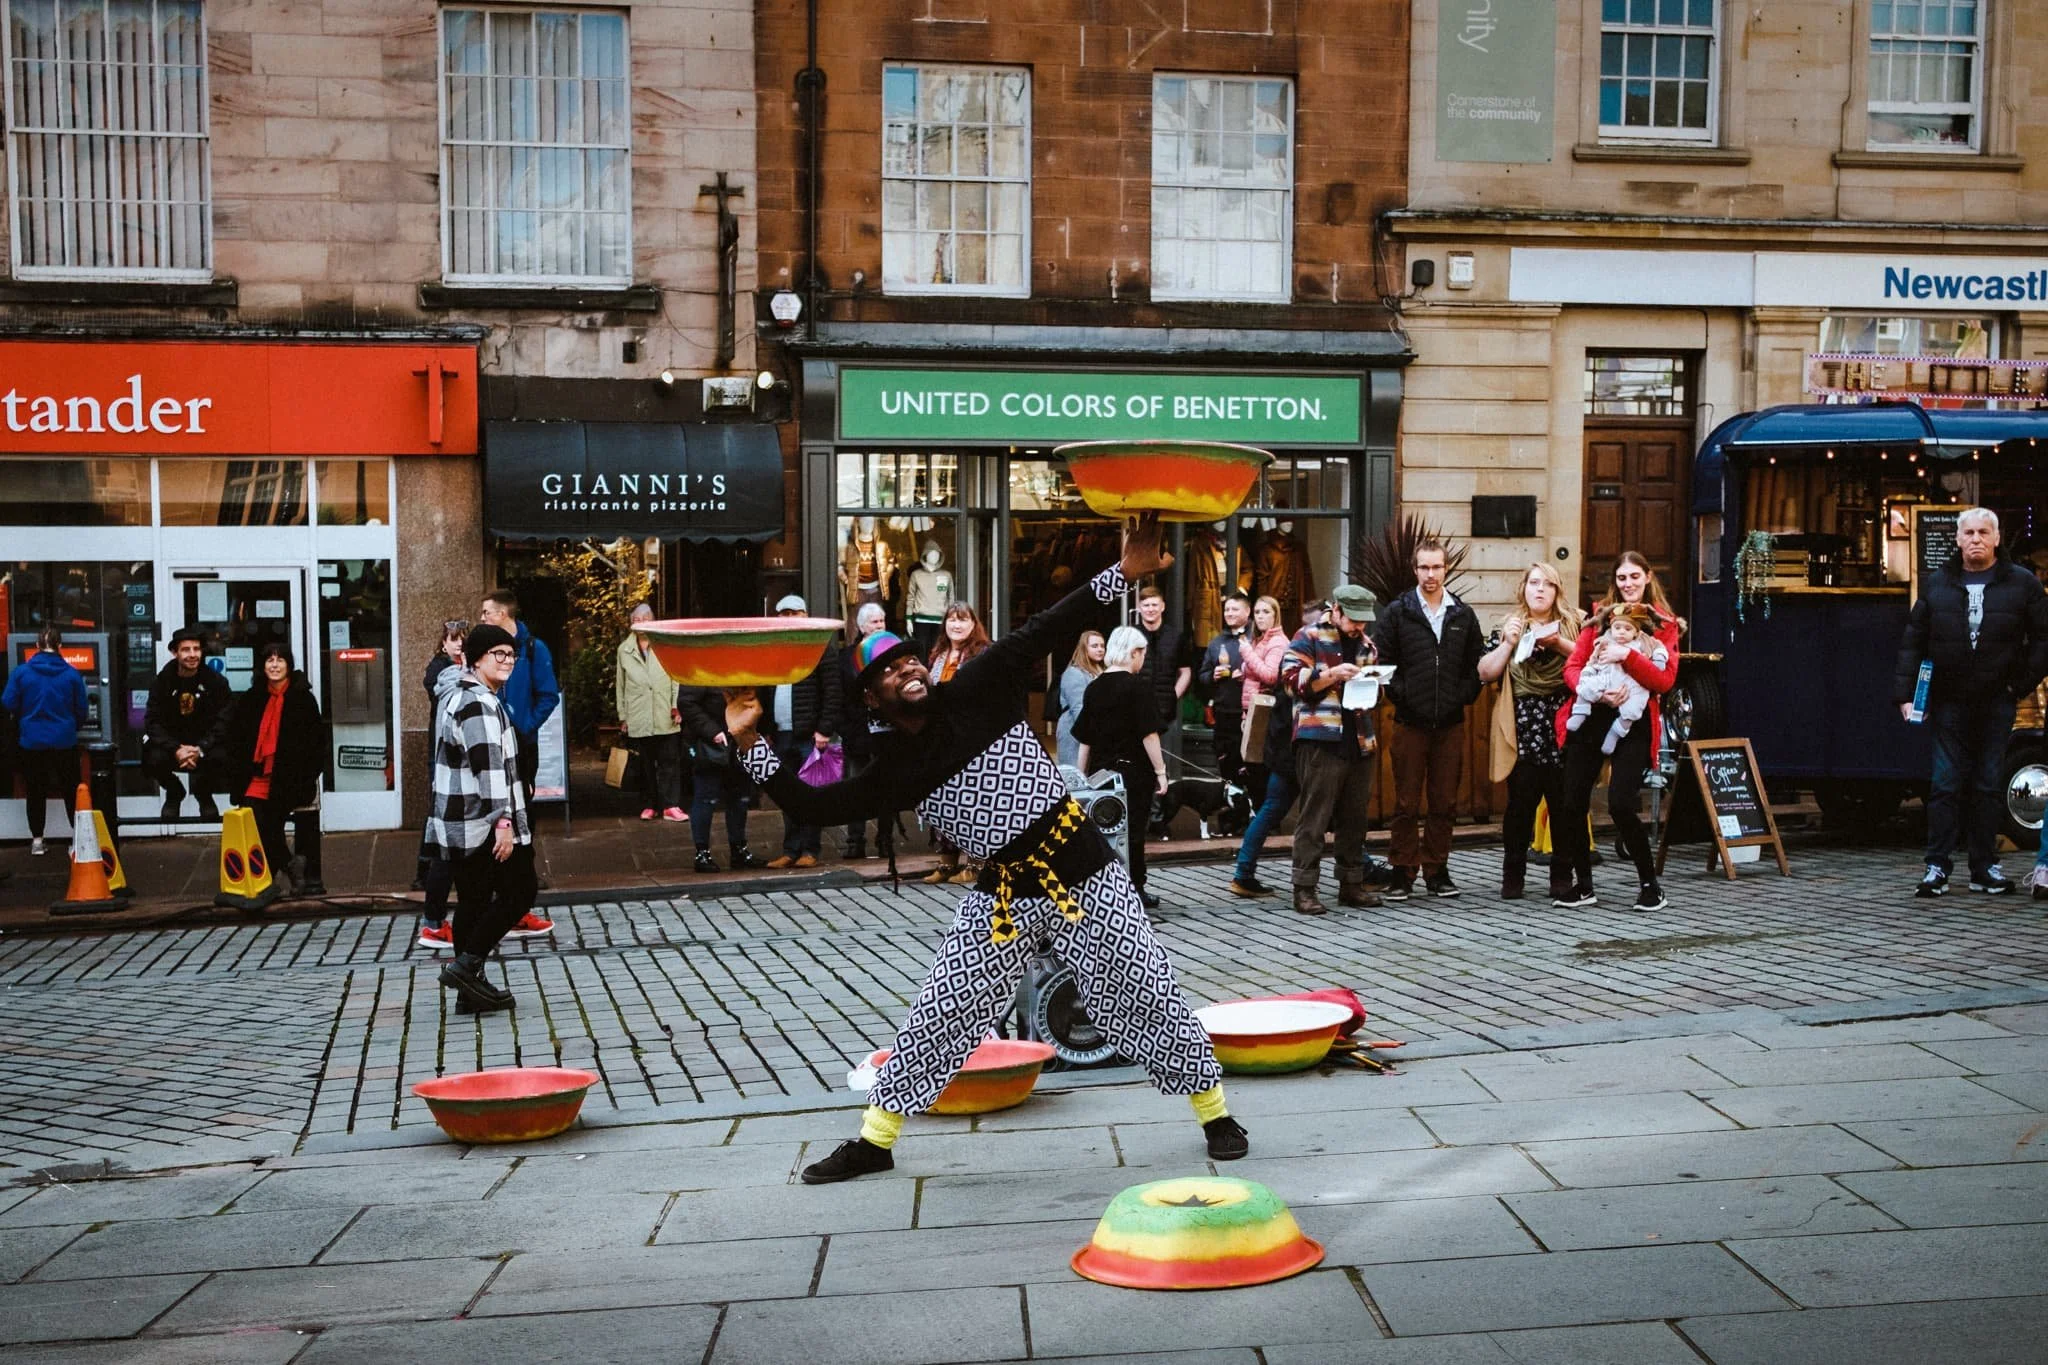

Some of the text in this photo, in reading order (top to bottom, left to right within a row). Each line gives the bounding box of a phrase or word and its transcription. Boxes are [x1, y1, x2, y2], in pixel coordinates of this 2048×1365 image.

[1457, 0, 1498, 53] nity
[1447, 93, 1536, 108] Cornerstone of
[1447, 106, 1542, 124] the community
[1884, 266, 2048, 301] Newcastl
[1822, 361, 1888, 390] THE
[0, 374, 212, 434] tander
[880, 390, 1328, 421] UNITED COLORS OF BENETTON.
[542, 473, 727, 496] GIANNI'S
[544, 499, 727, 513] ristorante pizzeria
